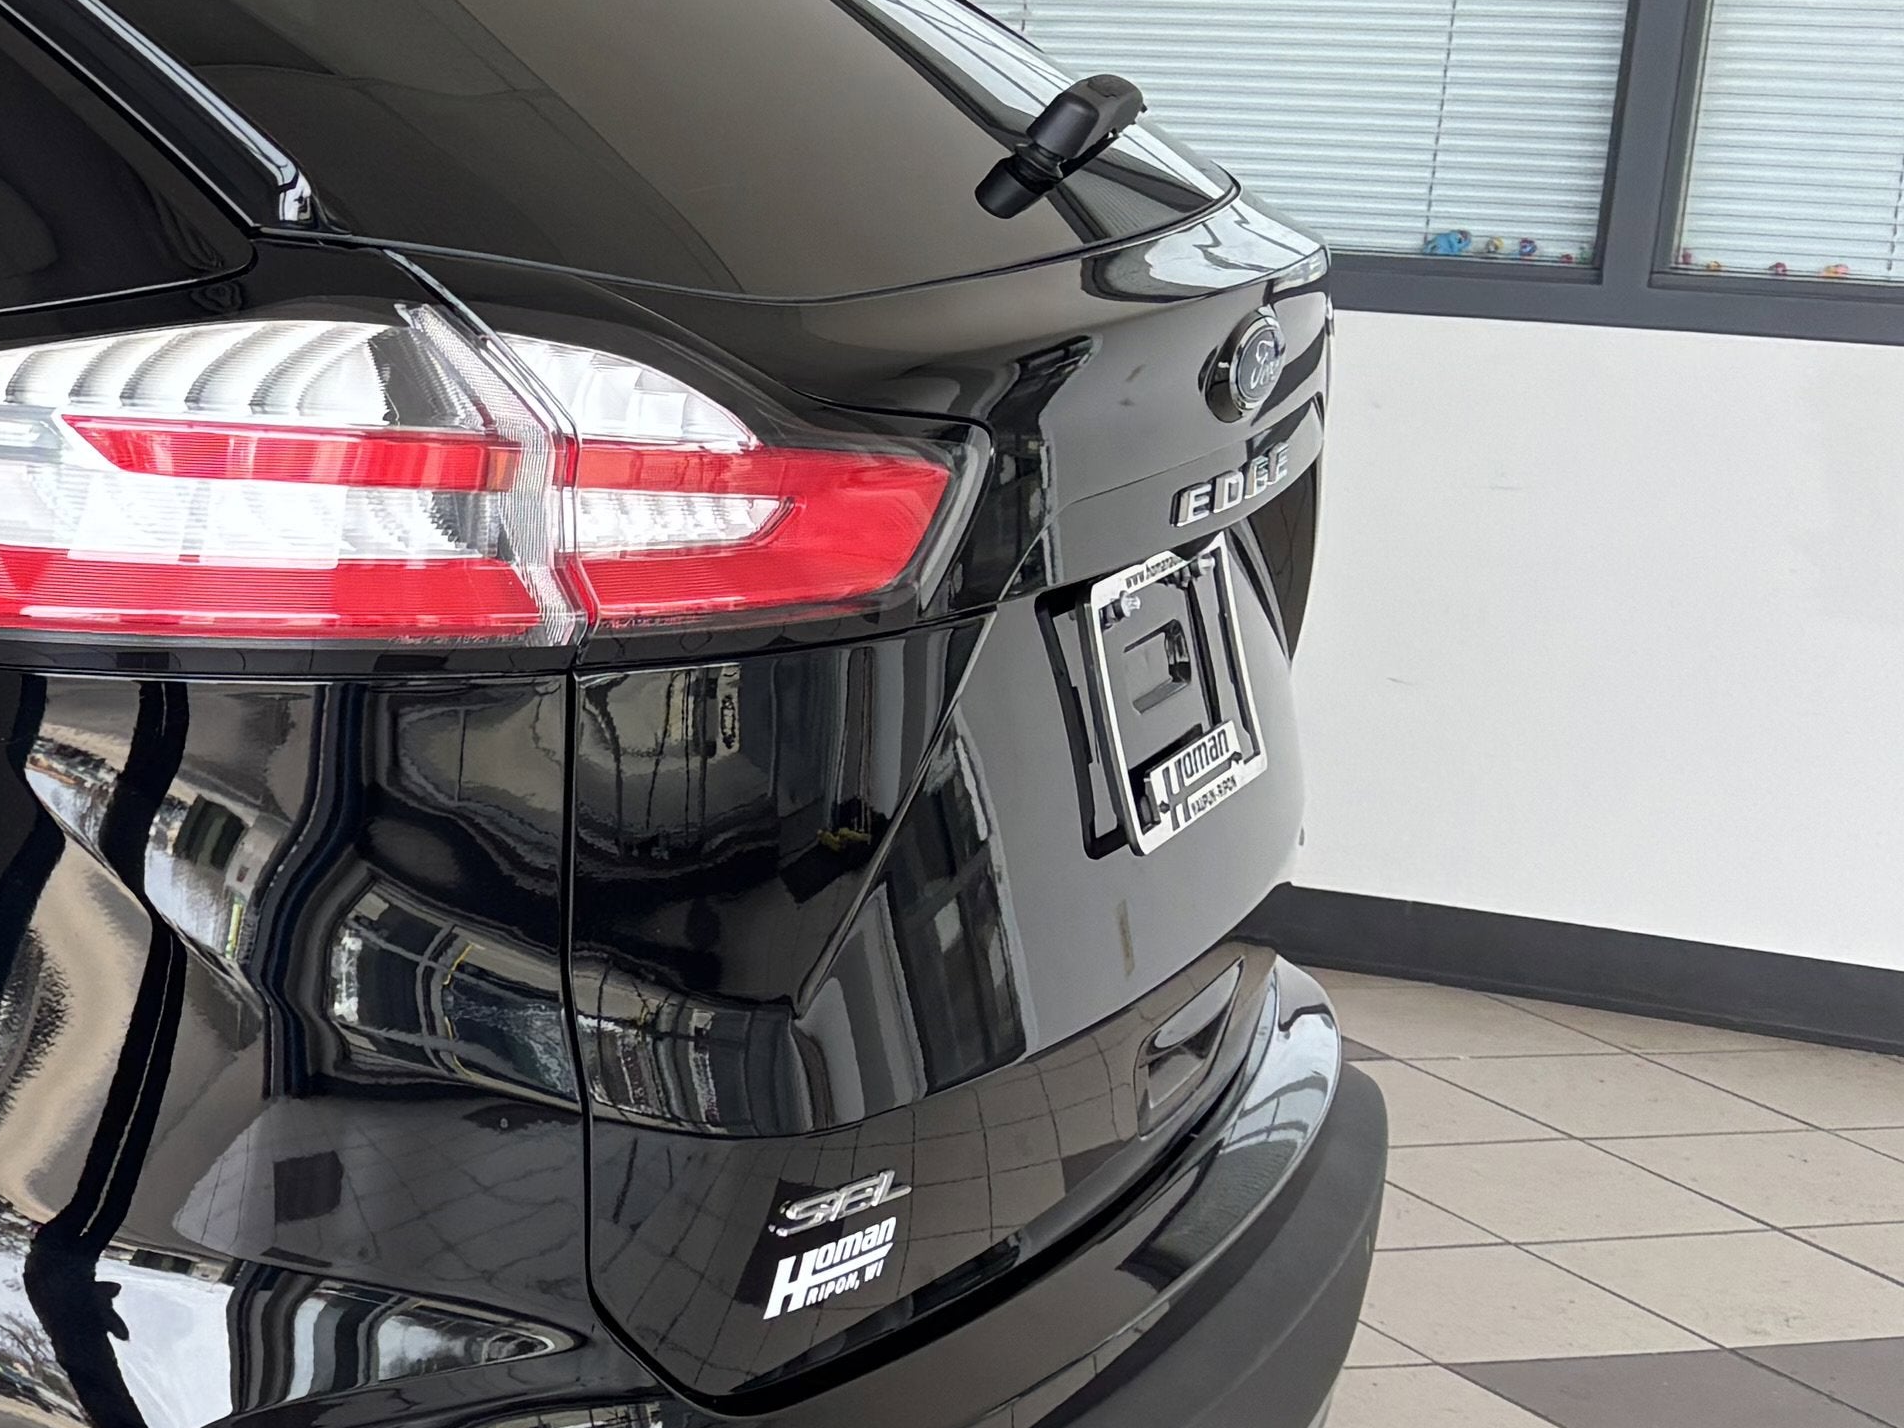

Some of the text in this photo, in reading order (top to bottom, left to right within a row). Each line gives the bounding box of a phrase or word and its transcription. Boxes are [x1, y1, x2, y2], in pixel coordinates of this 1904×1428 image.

[1178, 443, 1290, 527] EDGE
[1162, 728, 1230, 833] Homan
[771, 1168, 913, 1238] SEL
[762, 1216, 898, 1321] Homan
[805, 1258, 885, 1307] RIPON, WI
